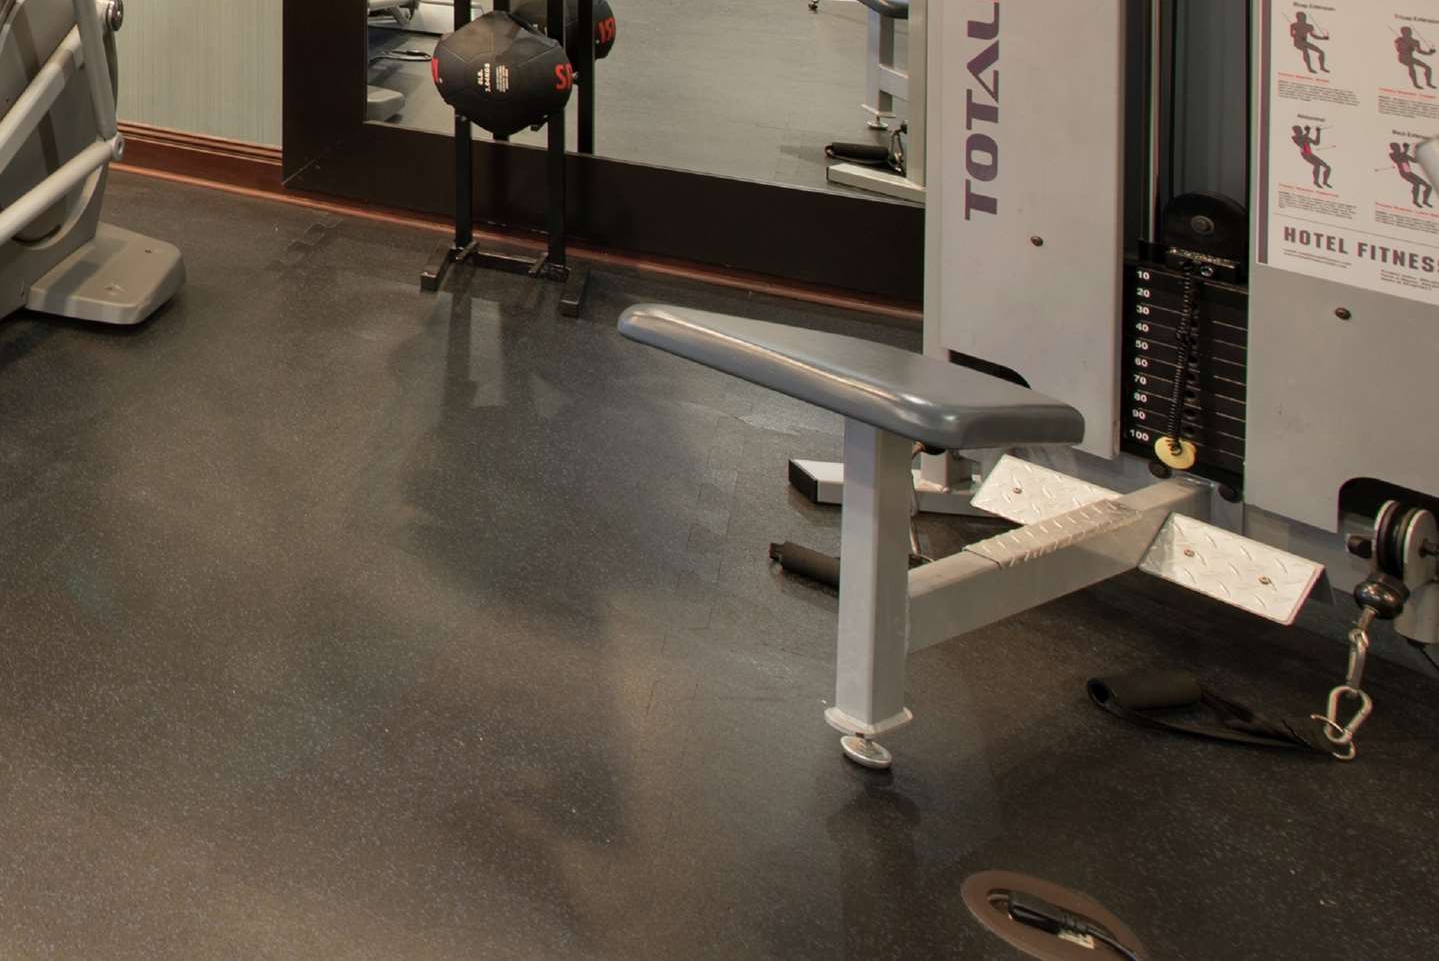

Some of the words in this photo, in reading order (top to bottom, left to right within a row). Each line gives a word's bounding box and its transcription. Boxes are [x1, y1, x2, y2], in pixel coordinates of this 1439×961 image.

[1284, 226, 1349, 255] HOTEL
[1357, 242, 1439, 274] FITNES
[1136, 270, 1150, 281] 10
[1136, 287, 1150, 298] 20
[1136, 304, 1150, 315] 30
[1135, 322, 1149, 333] 40
[1135, 339, 1149, 351] 50
[1134, 357, 1148, 368] 60
[1133, 374, 1147, 385] 70
[1133, 391, 1147, 403] 80
[1132, 408, 1146, 420] 90
[1129, 428, 1150, 442] 100
